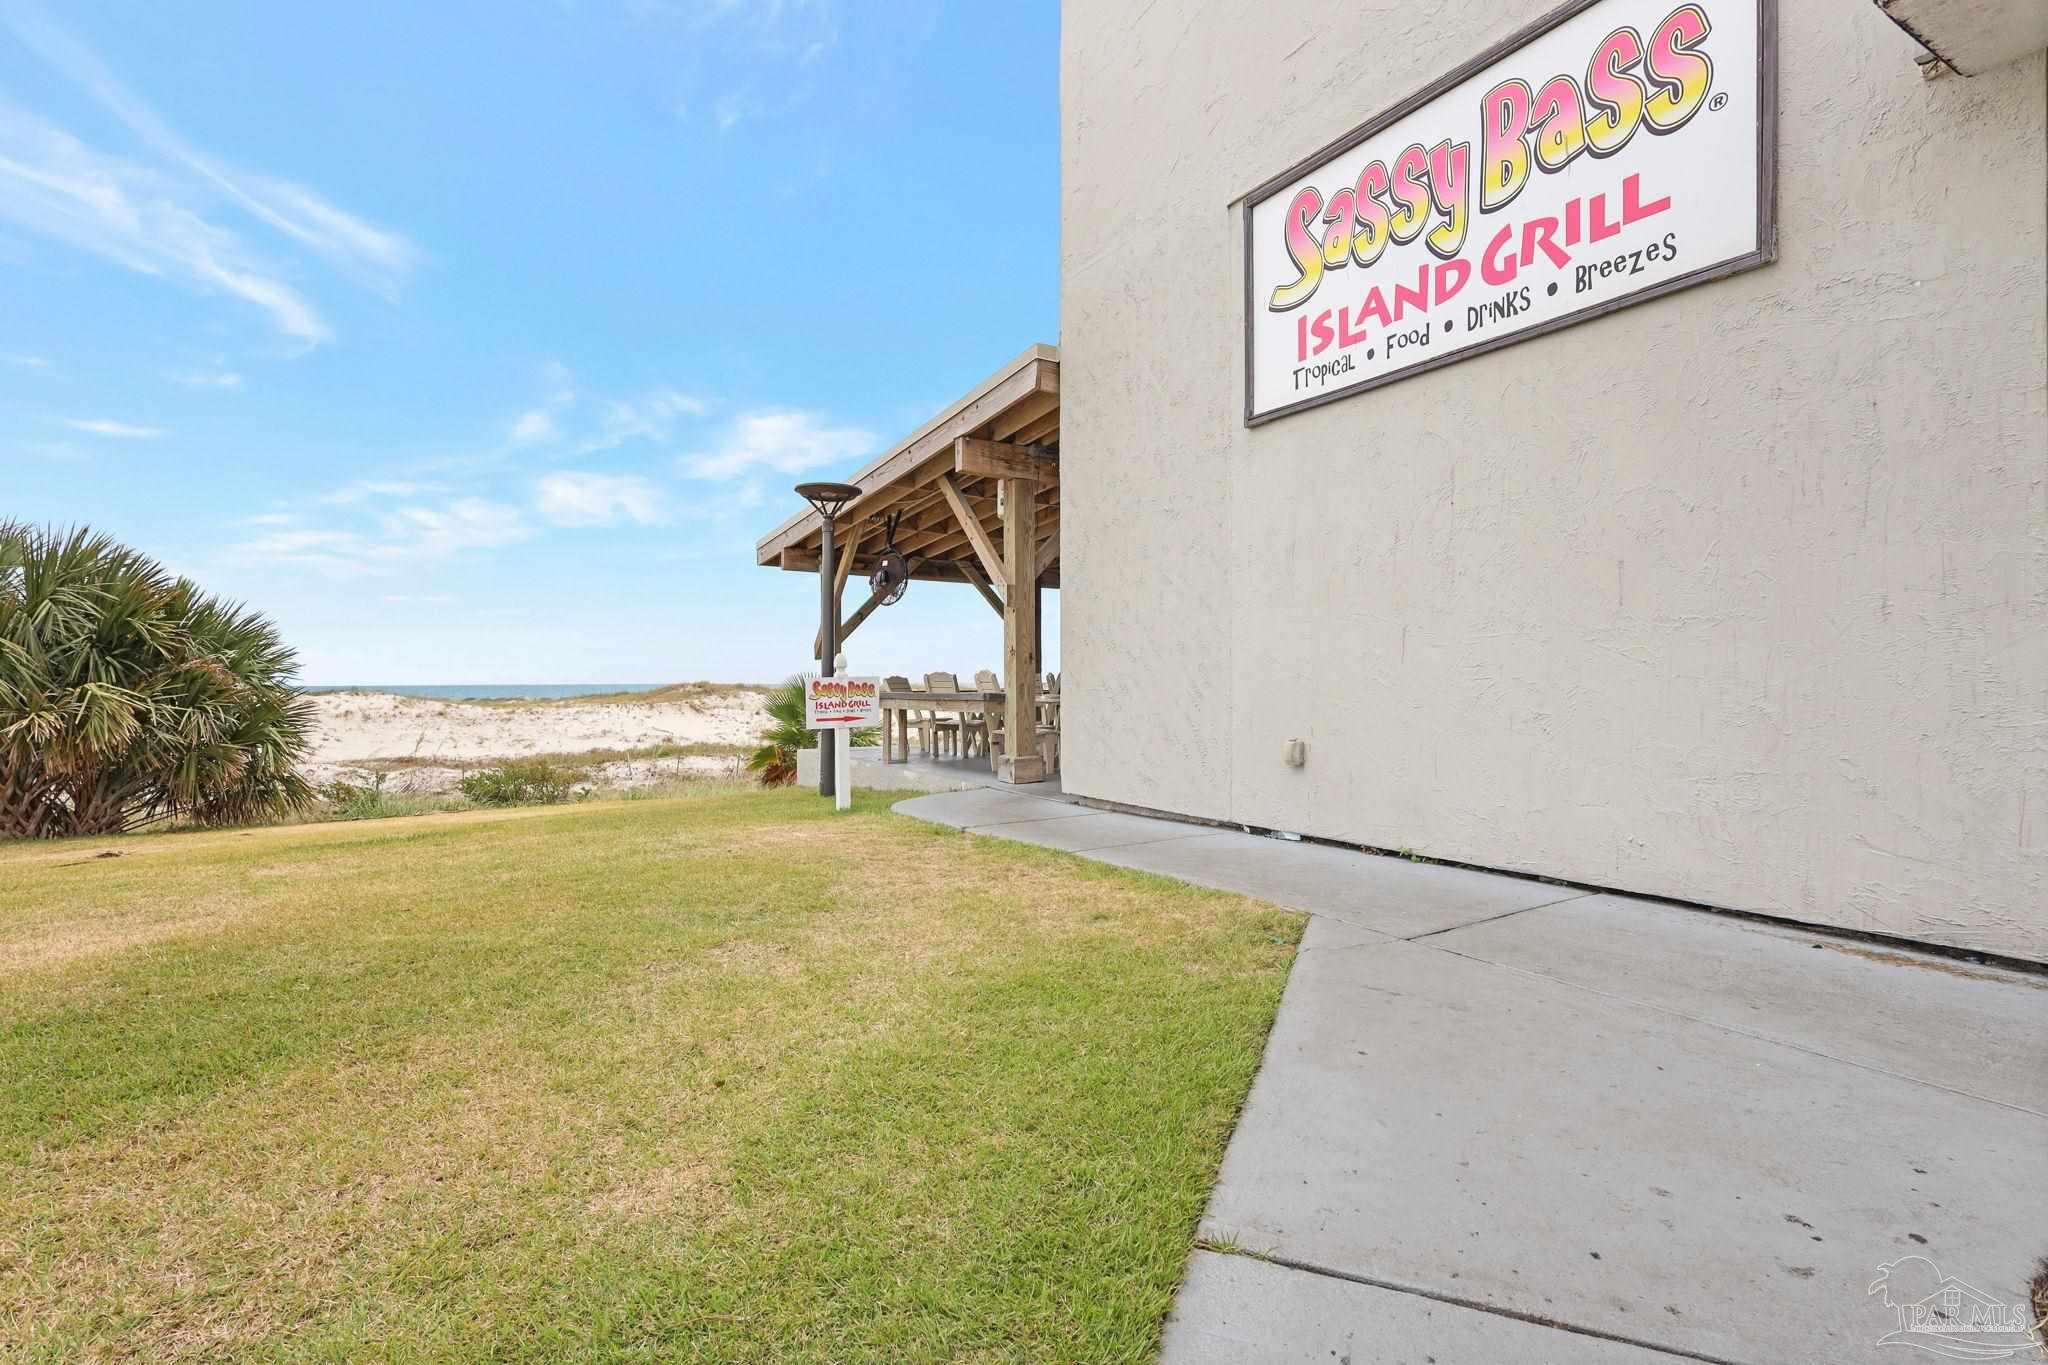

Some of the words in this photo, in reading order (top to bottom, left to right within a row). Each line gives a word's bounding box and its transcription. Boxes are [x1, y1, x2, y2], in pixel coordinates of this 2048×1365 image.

[1269, 139, 1470, 313] Sassy
[1297, 258, 1471, 362] ISLAND
[1481, 172, 1672, 286] GRILL
[1386, 322, 1430, 360] Food
[815, 700, 847, 710] ISLAND
[848, 700, 871, 708] GRILL
